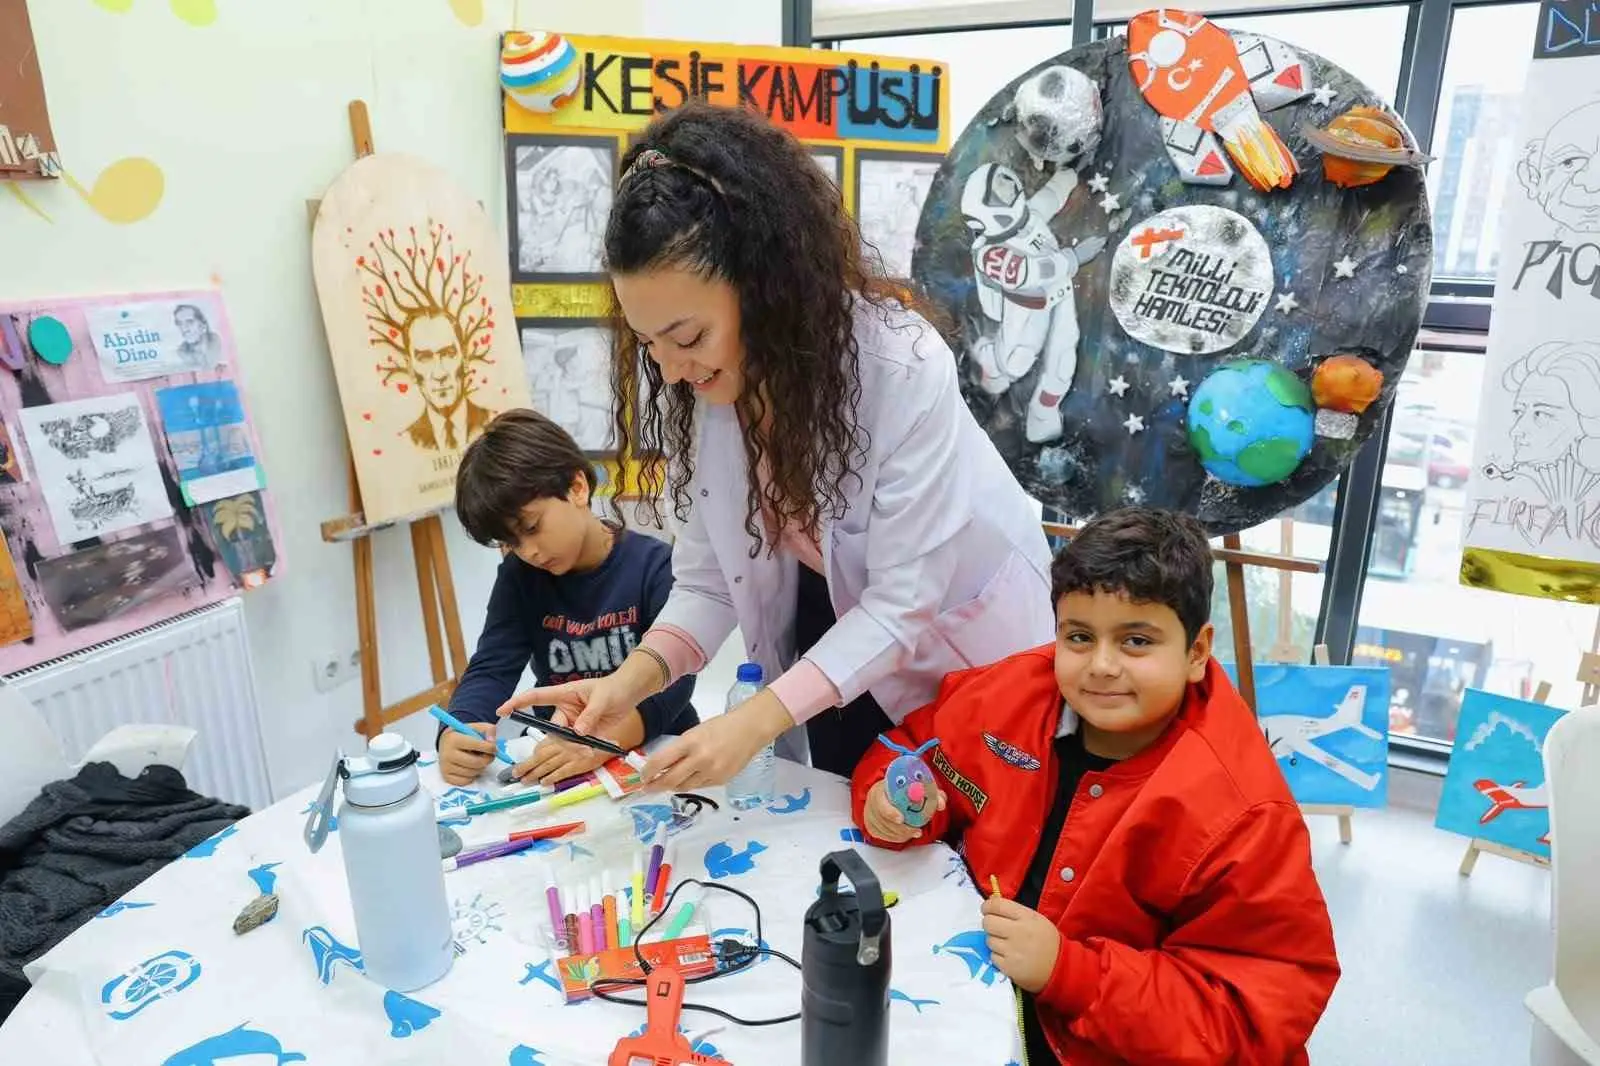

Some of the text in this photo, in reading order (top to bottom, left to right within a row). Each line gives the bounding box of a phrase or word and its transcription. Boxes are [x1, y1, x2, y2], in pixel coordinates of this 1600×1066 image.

[104, 329, 160, 348] Abidin
[116, 348, 158, 364] Dino
[934, 752, 986, 811] SPEED HOUSE
